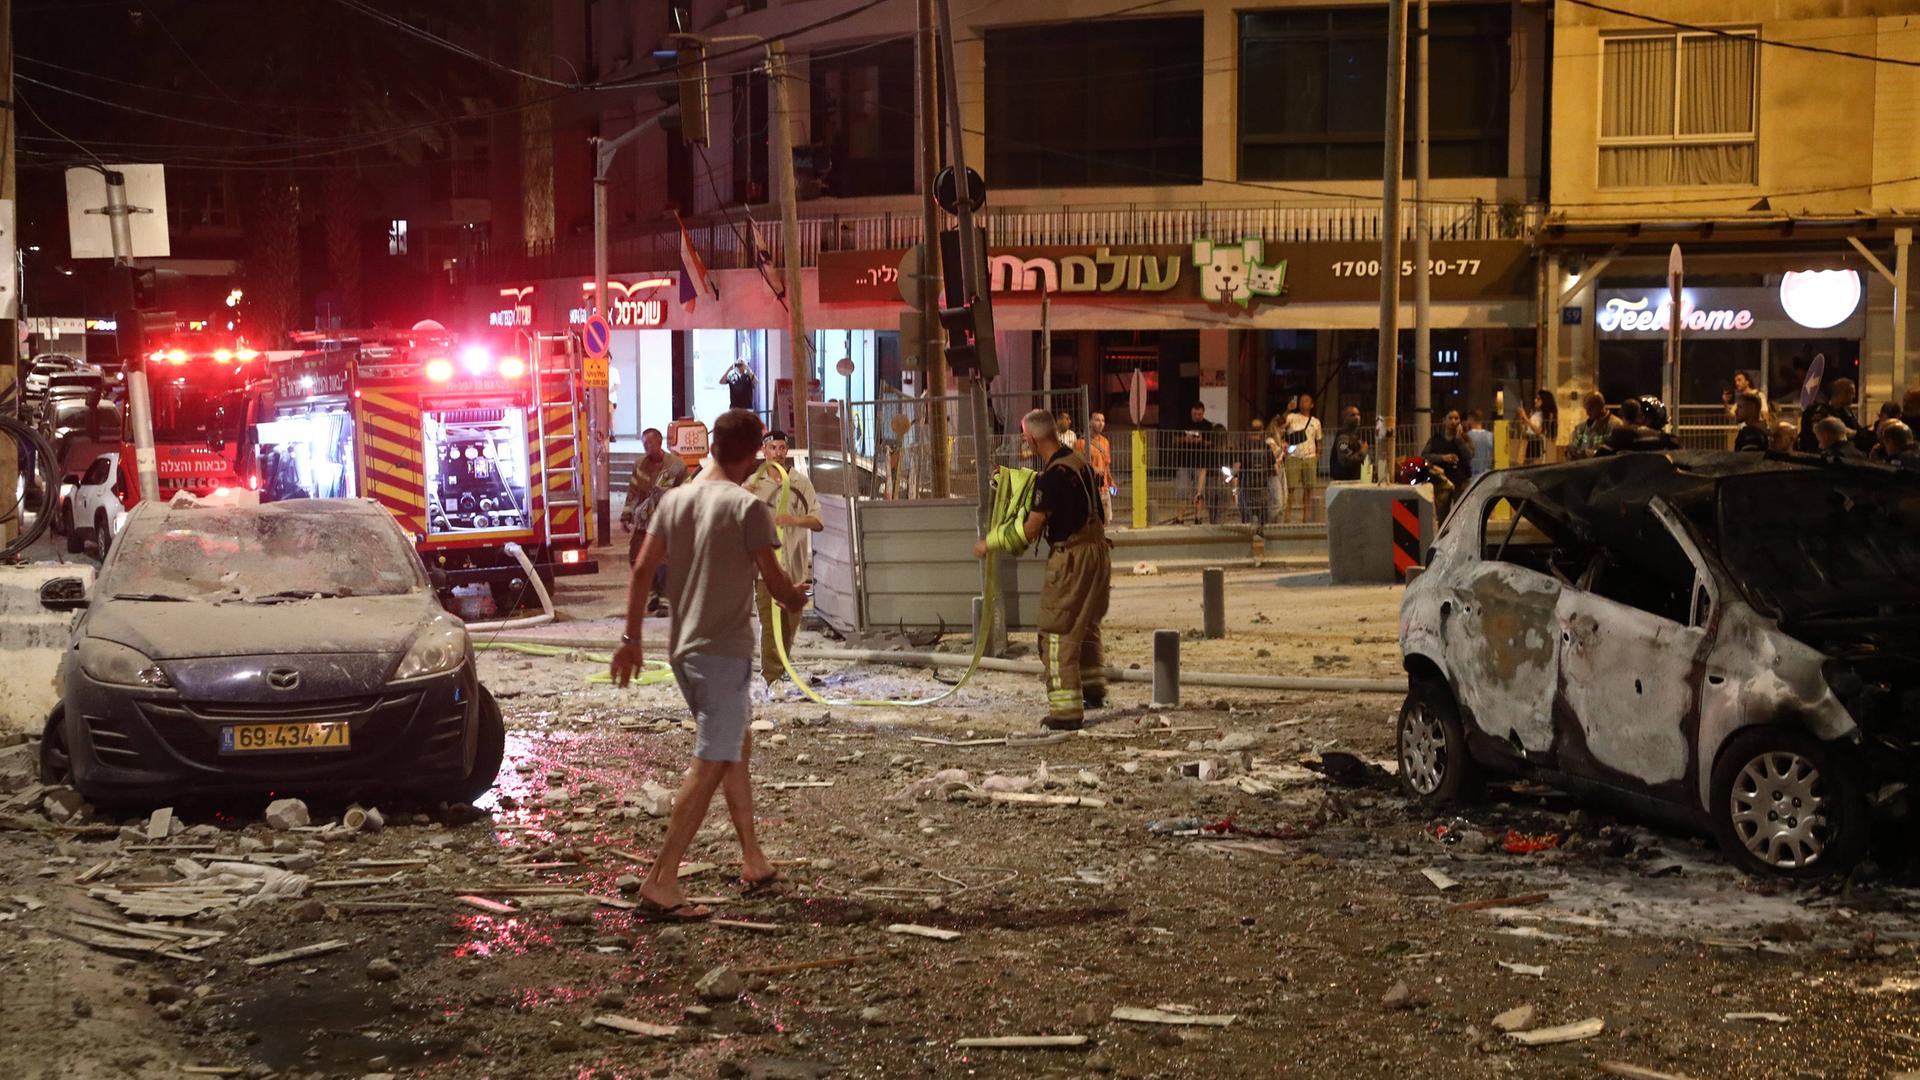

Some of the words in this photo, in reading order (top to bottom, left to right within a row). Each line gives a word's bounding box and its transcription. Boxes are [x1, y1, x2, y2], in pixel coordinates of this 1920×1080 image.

[1061, 248, 1180, 292] עולם
[1331, 259, 1481, 277] 1700-5-20-77
[614, 296, 661, 327] שופרסל
[1600, 297, 1665, 331] Feel
[160, 459, 192, 473] והצלה
[195, 460, 227, 473] כבאות
[168, 477, 220, 490] IVECO
